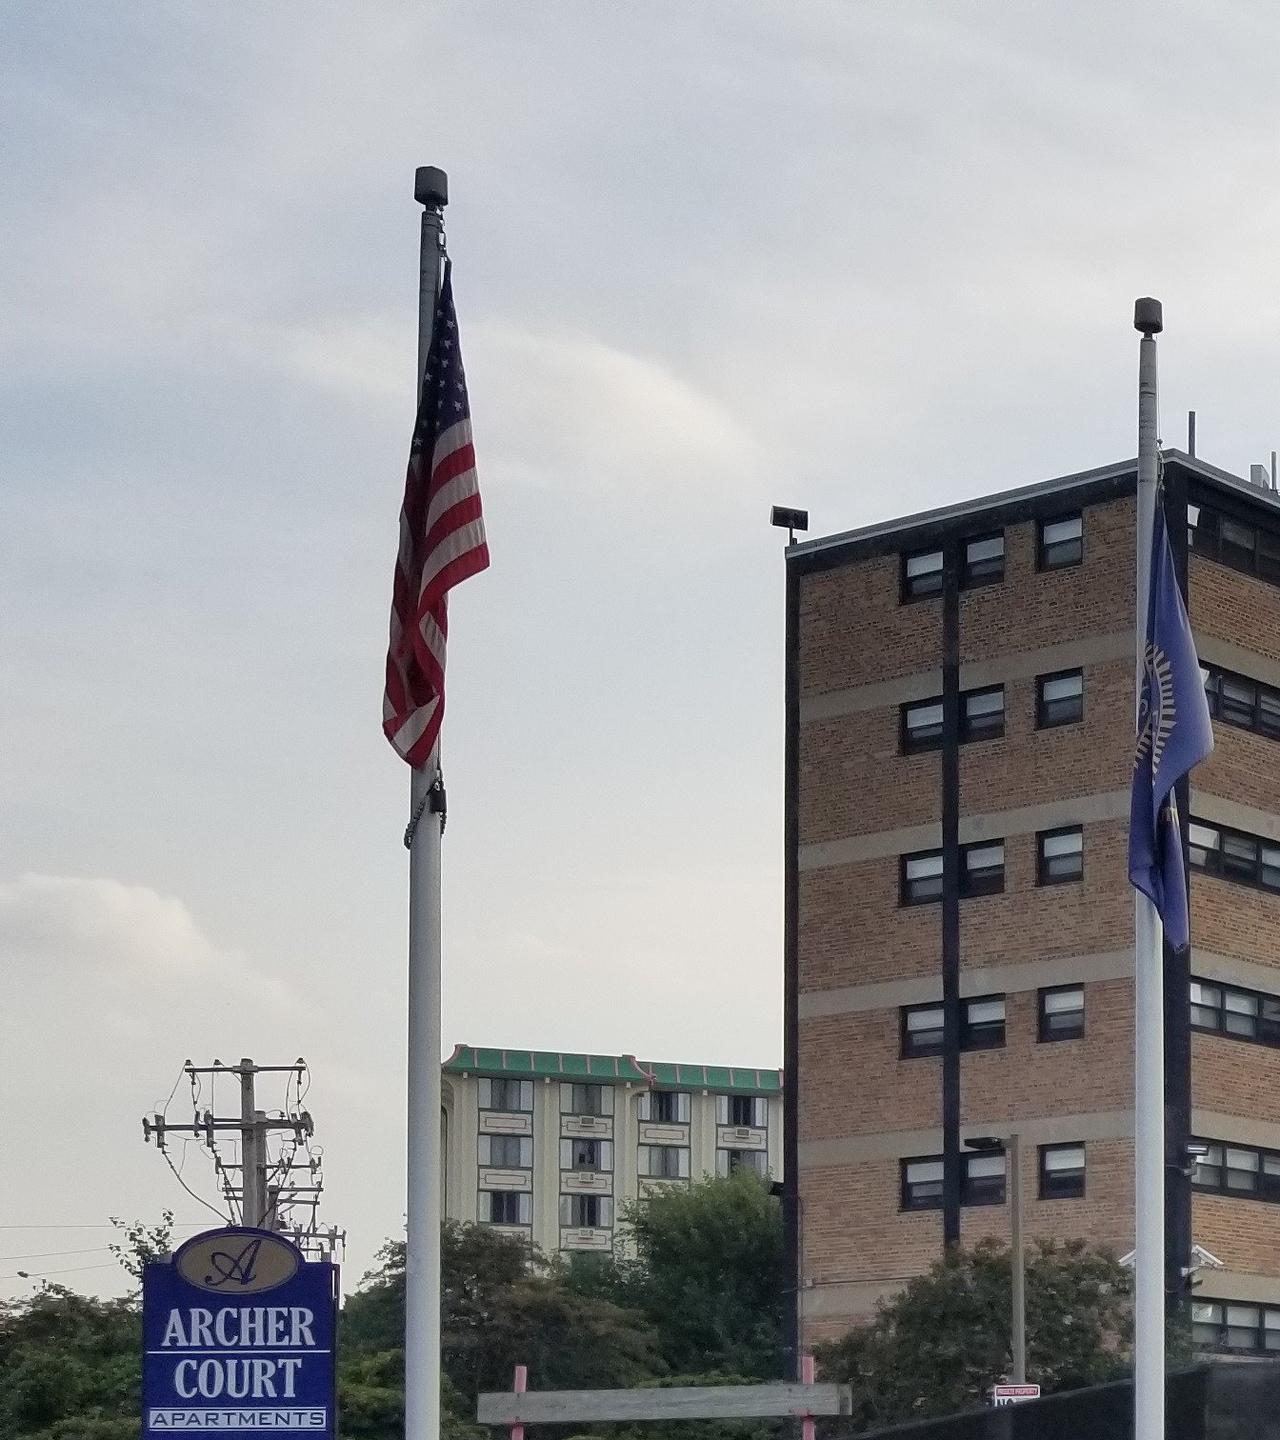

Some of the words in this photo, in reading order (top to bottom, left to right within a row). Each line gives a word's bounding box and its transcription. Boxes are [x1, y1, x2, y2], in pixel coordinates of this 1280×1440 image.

[205, 1239, 262, 1286] A
[161, 1307, 316, 1346] ARCHER
[175, 1358, 303, 1398] COURT
[152, 1412, 324, 1426] APARTMENTS
